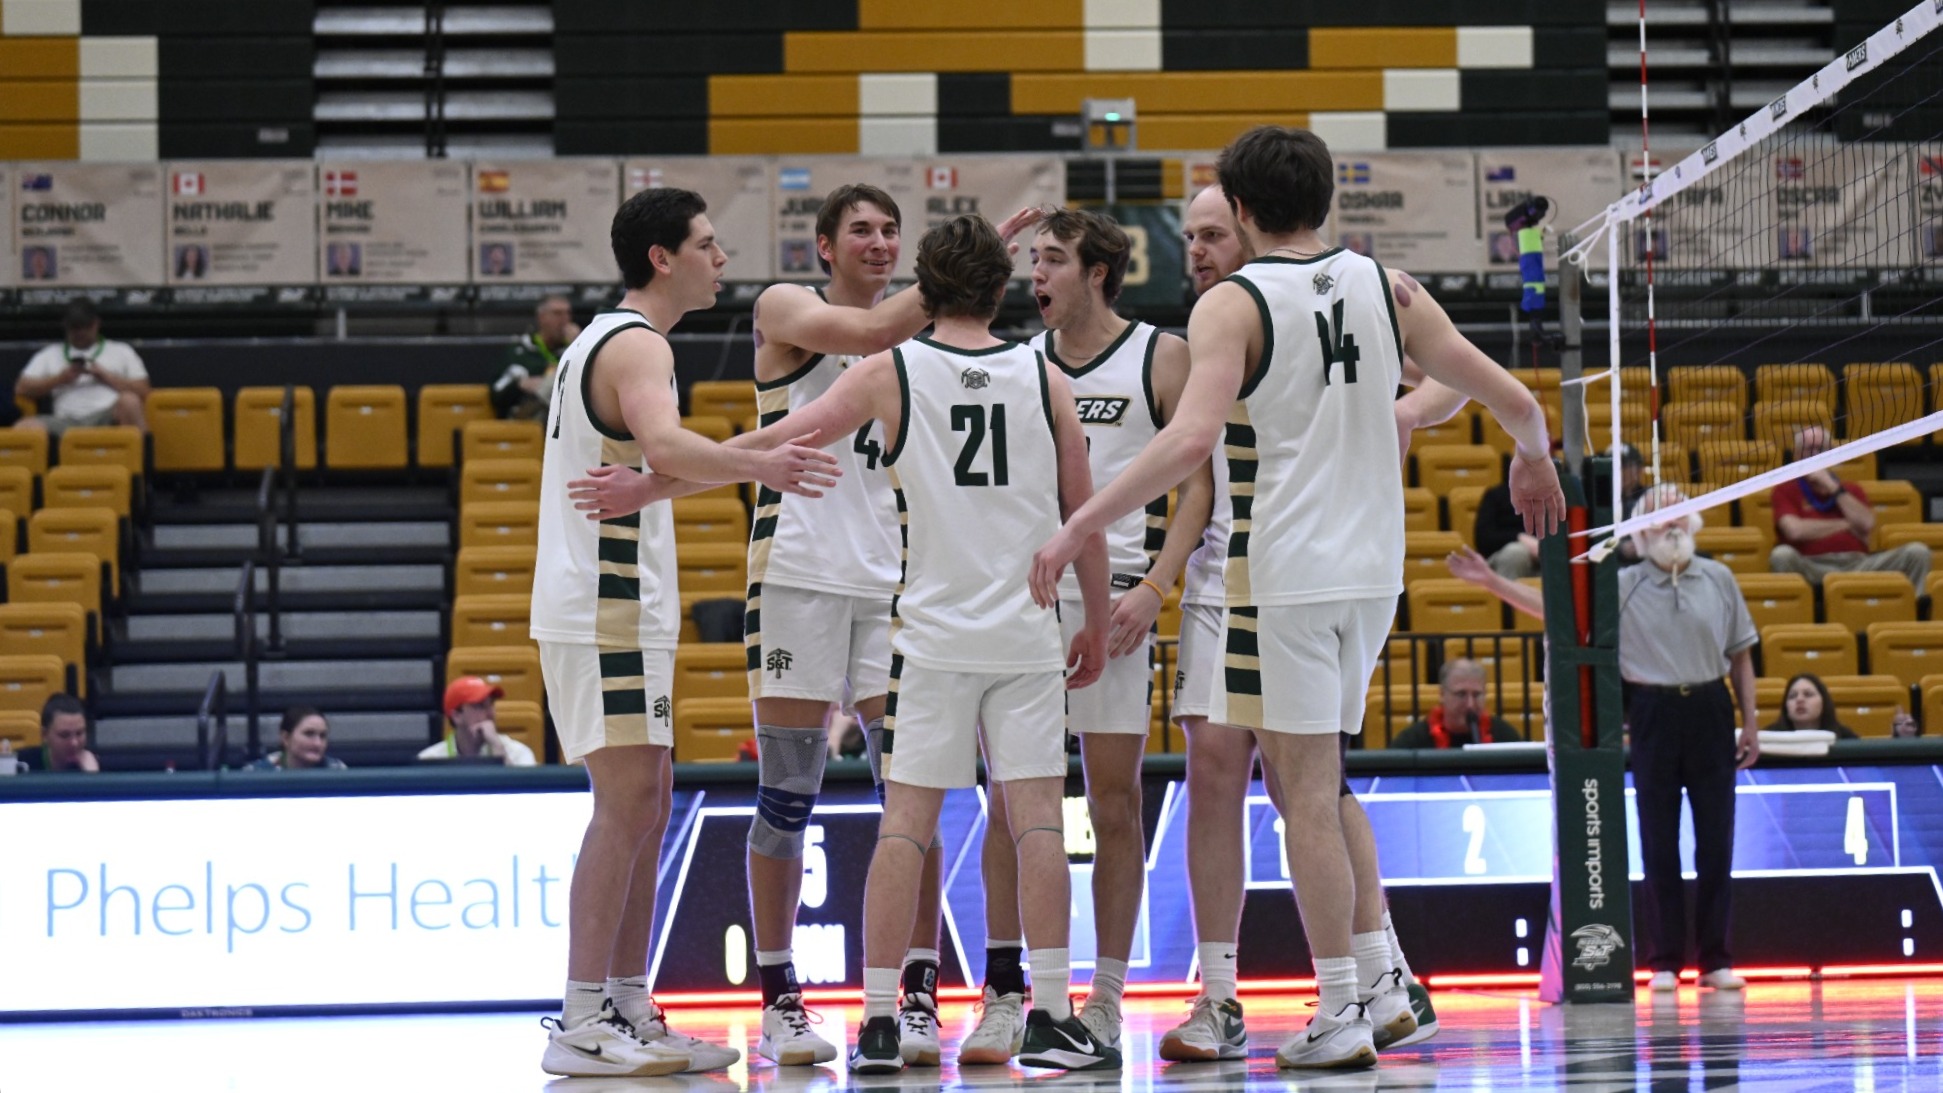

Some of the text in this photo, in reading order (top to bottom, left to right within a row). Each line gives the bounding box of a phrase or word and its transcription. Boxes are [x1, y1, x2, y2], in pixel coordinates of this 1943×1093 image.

[22, 202, 106, 222] CONNOR
[174, 201, 275, 220] NATHALIE
[327, 201, 374, 219] MIKE
[480, 199, 567, 218] WILLIAM
[1314, 298, 1360, 386] 14
[1076, 399, 1124, 420] ERS
[950, 403, 1009, 486] 21
[1462, 804, 1487, 875] 2
[1844, 796, 1868, 866] 4
[1581, 778, 1605, 910] sports imports
[46, 853, 577, 954] Phelps Healt
